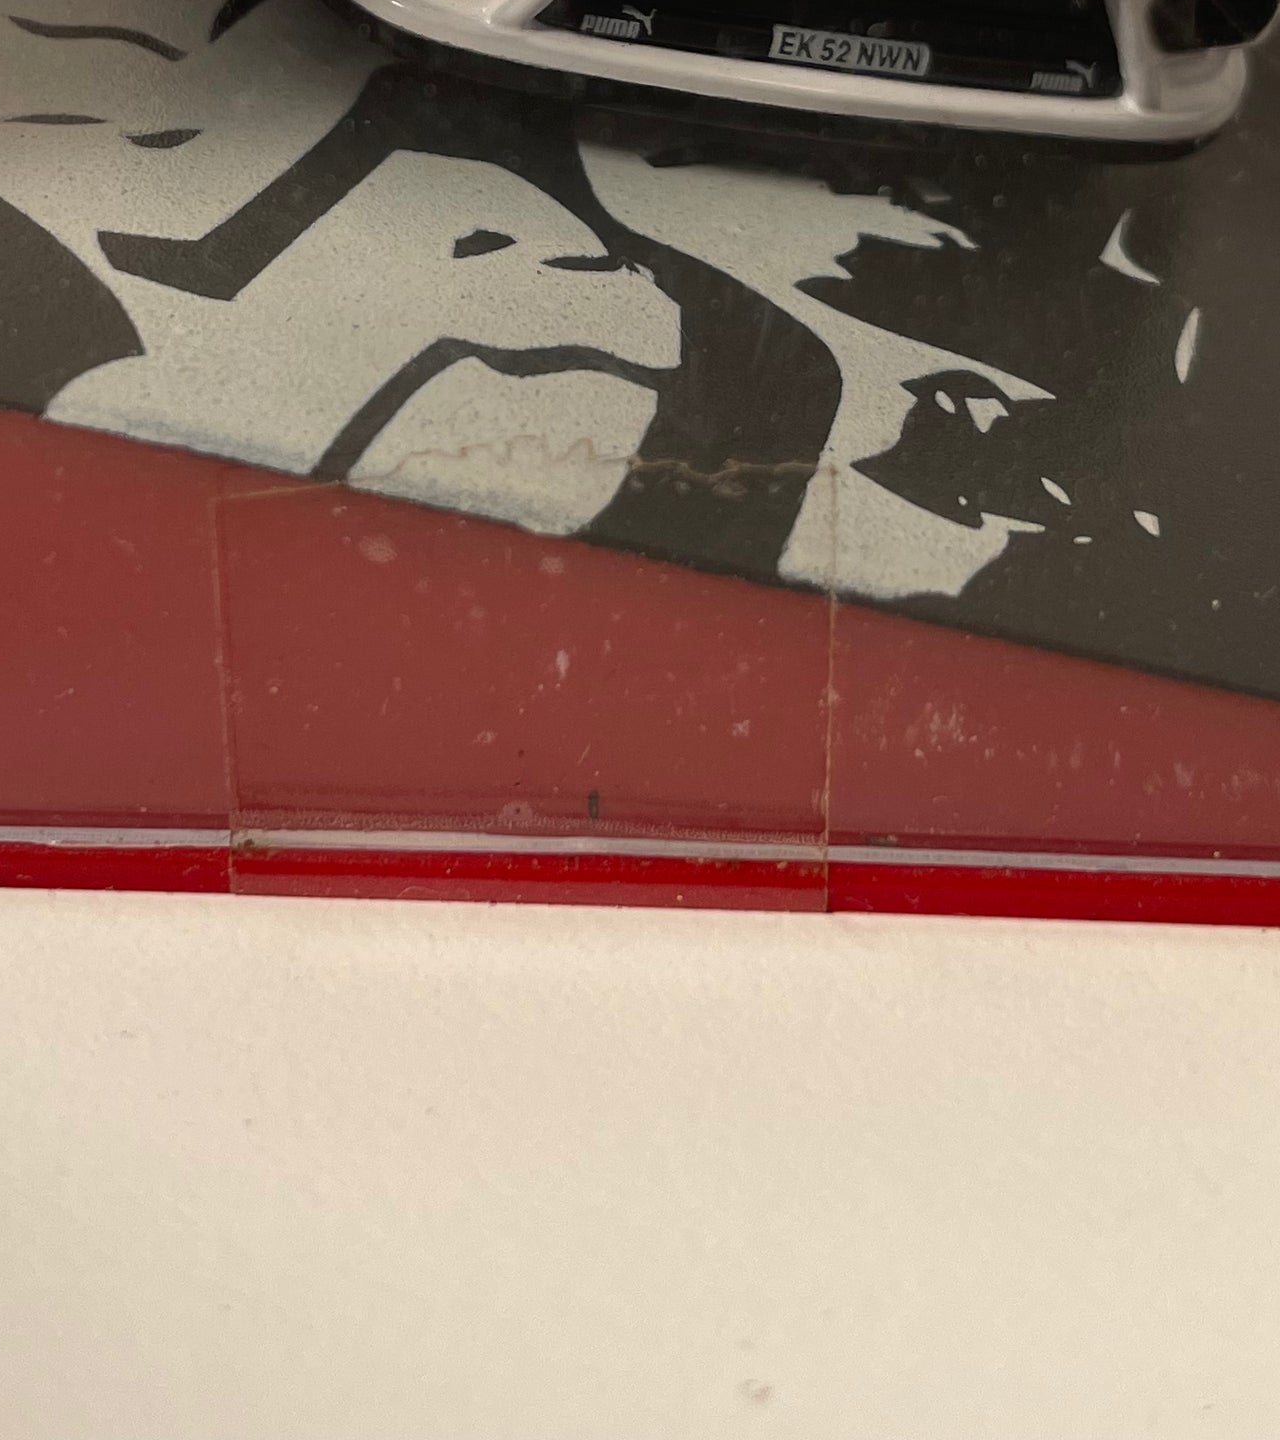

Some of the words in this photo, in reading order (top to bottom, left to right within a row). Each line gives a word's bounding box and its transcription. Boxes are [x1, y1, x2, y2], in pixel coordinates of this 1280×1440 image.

[778, 30, 817, 59] EK
[820, 37, 852, 65] 52
[856, 41, 922, 73] NWN
